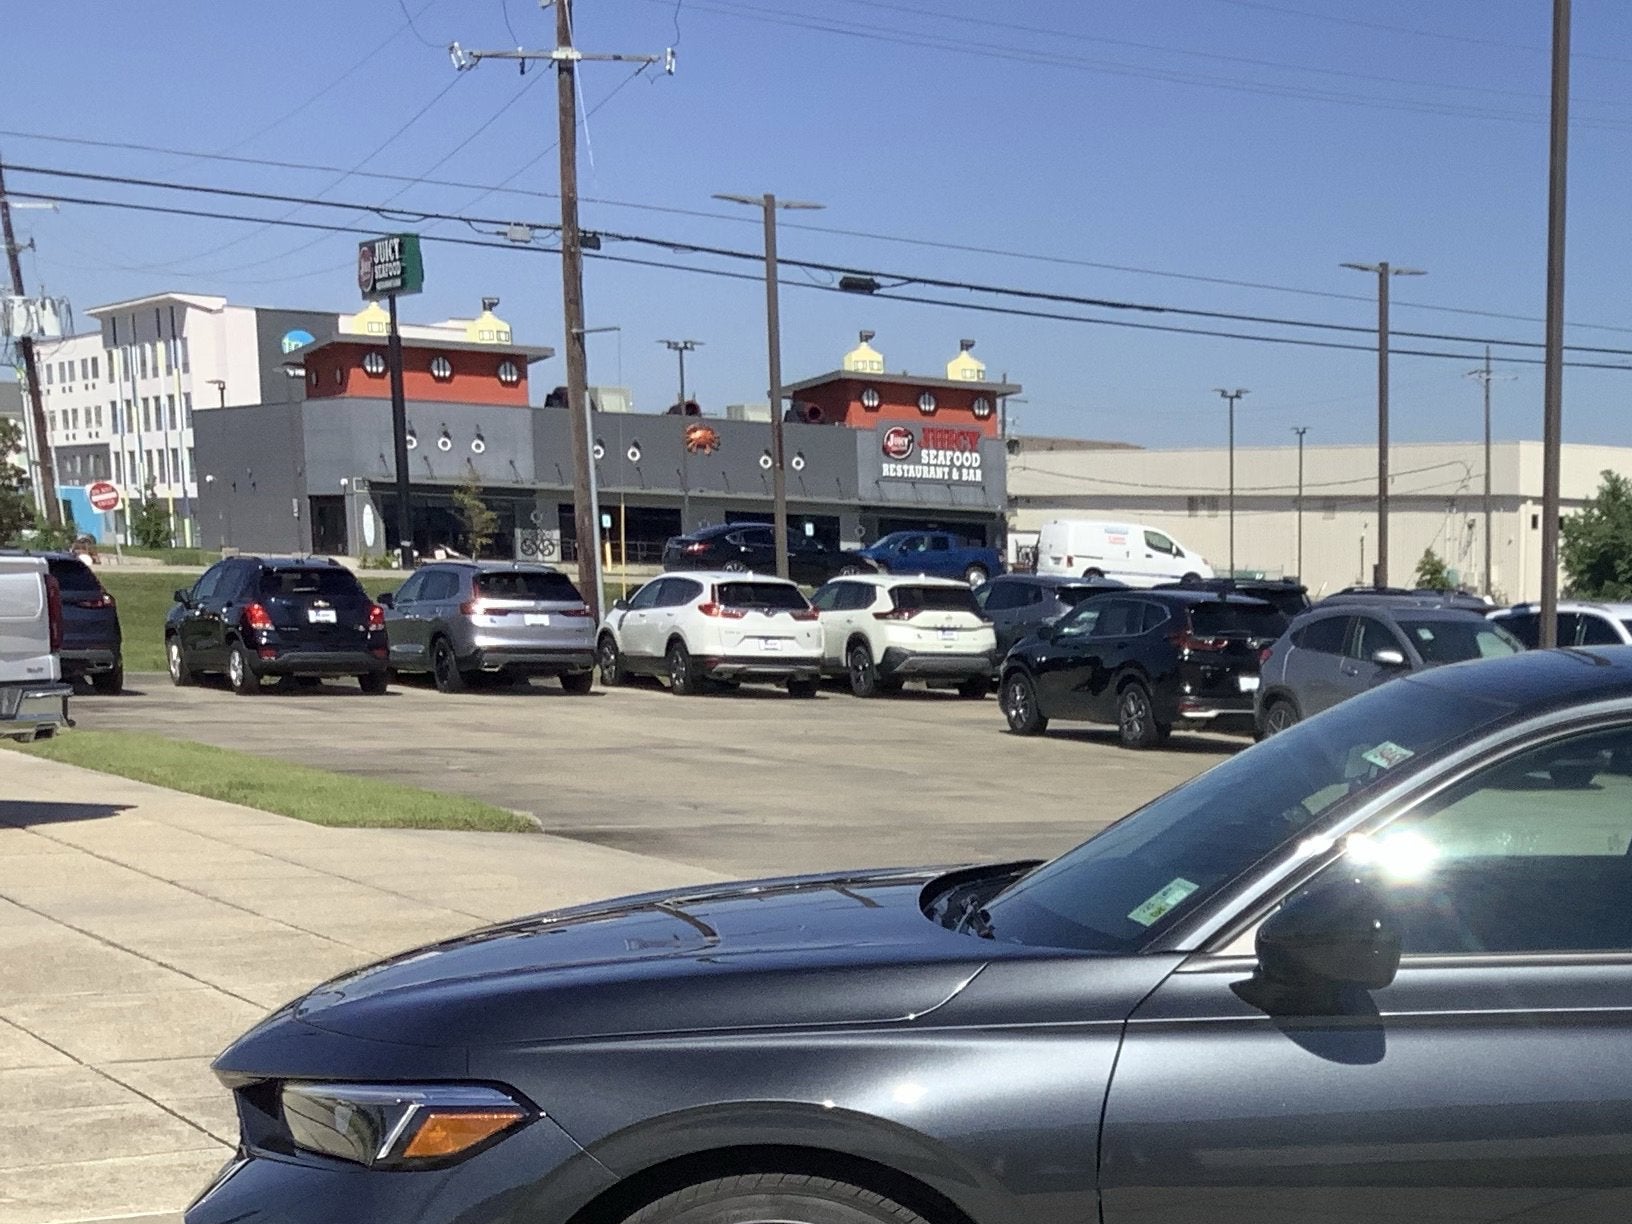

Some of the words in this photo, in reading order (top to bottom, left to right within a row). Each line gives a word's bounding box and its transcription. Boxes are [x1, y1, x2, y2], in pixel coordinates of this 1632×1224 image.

[374, 237, 400, 264] JUICY
[918, 427, 980, 451] JUICY
[921, 449, 980, 468] SEAFOOD
[882, 463, 949, 480] RESTAURANT
[952, 468, 960, 480] &
[962, 468, 982, 482] BAR
